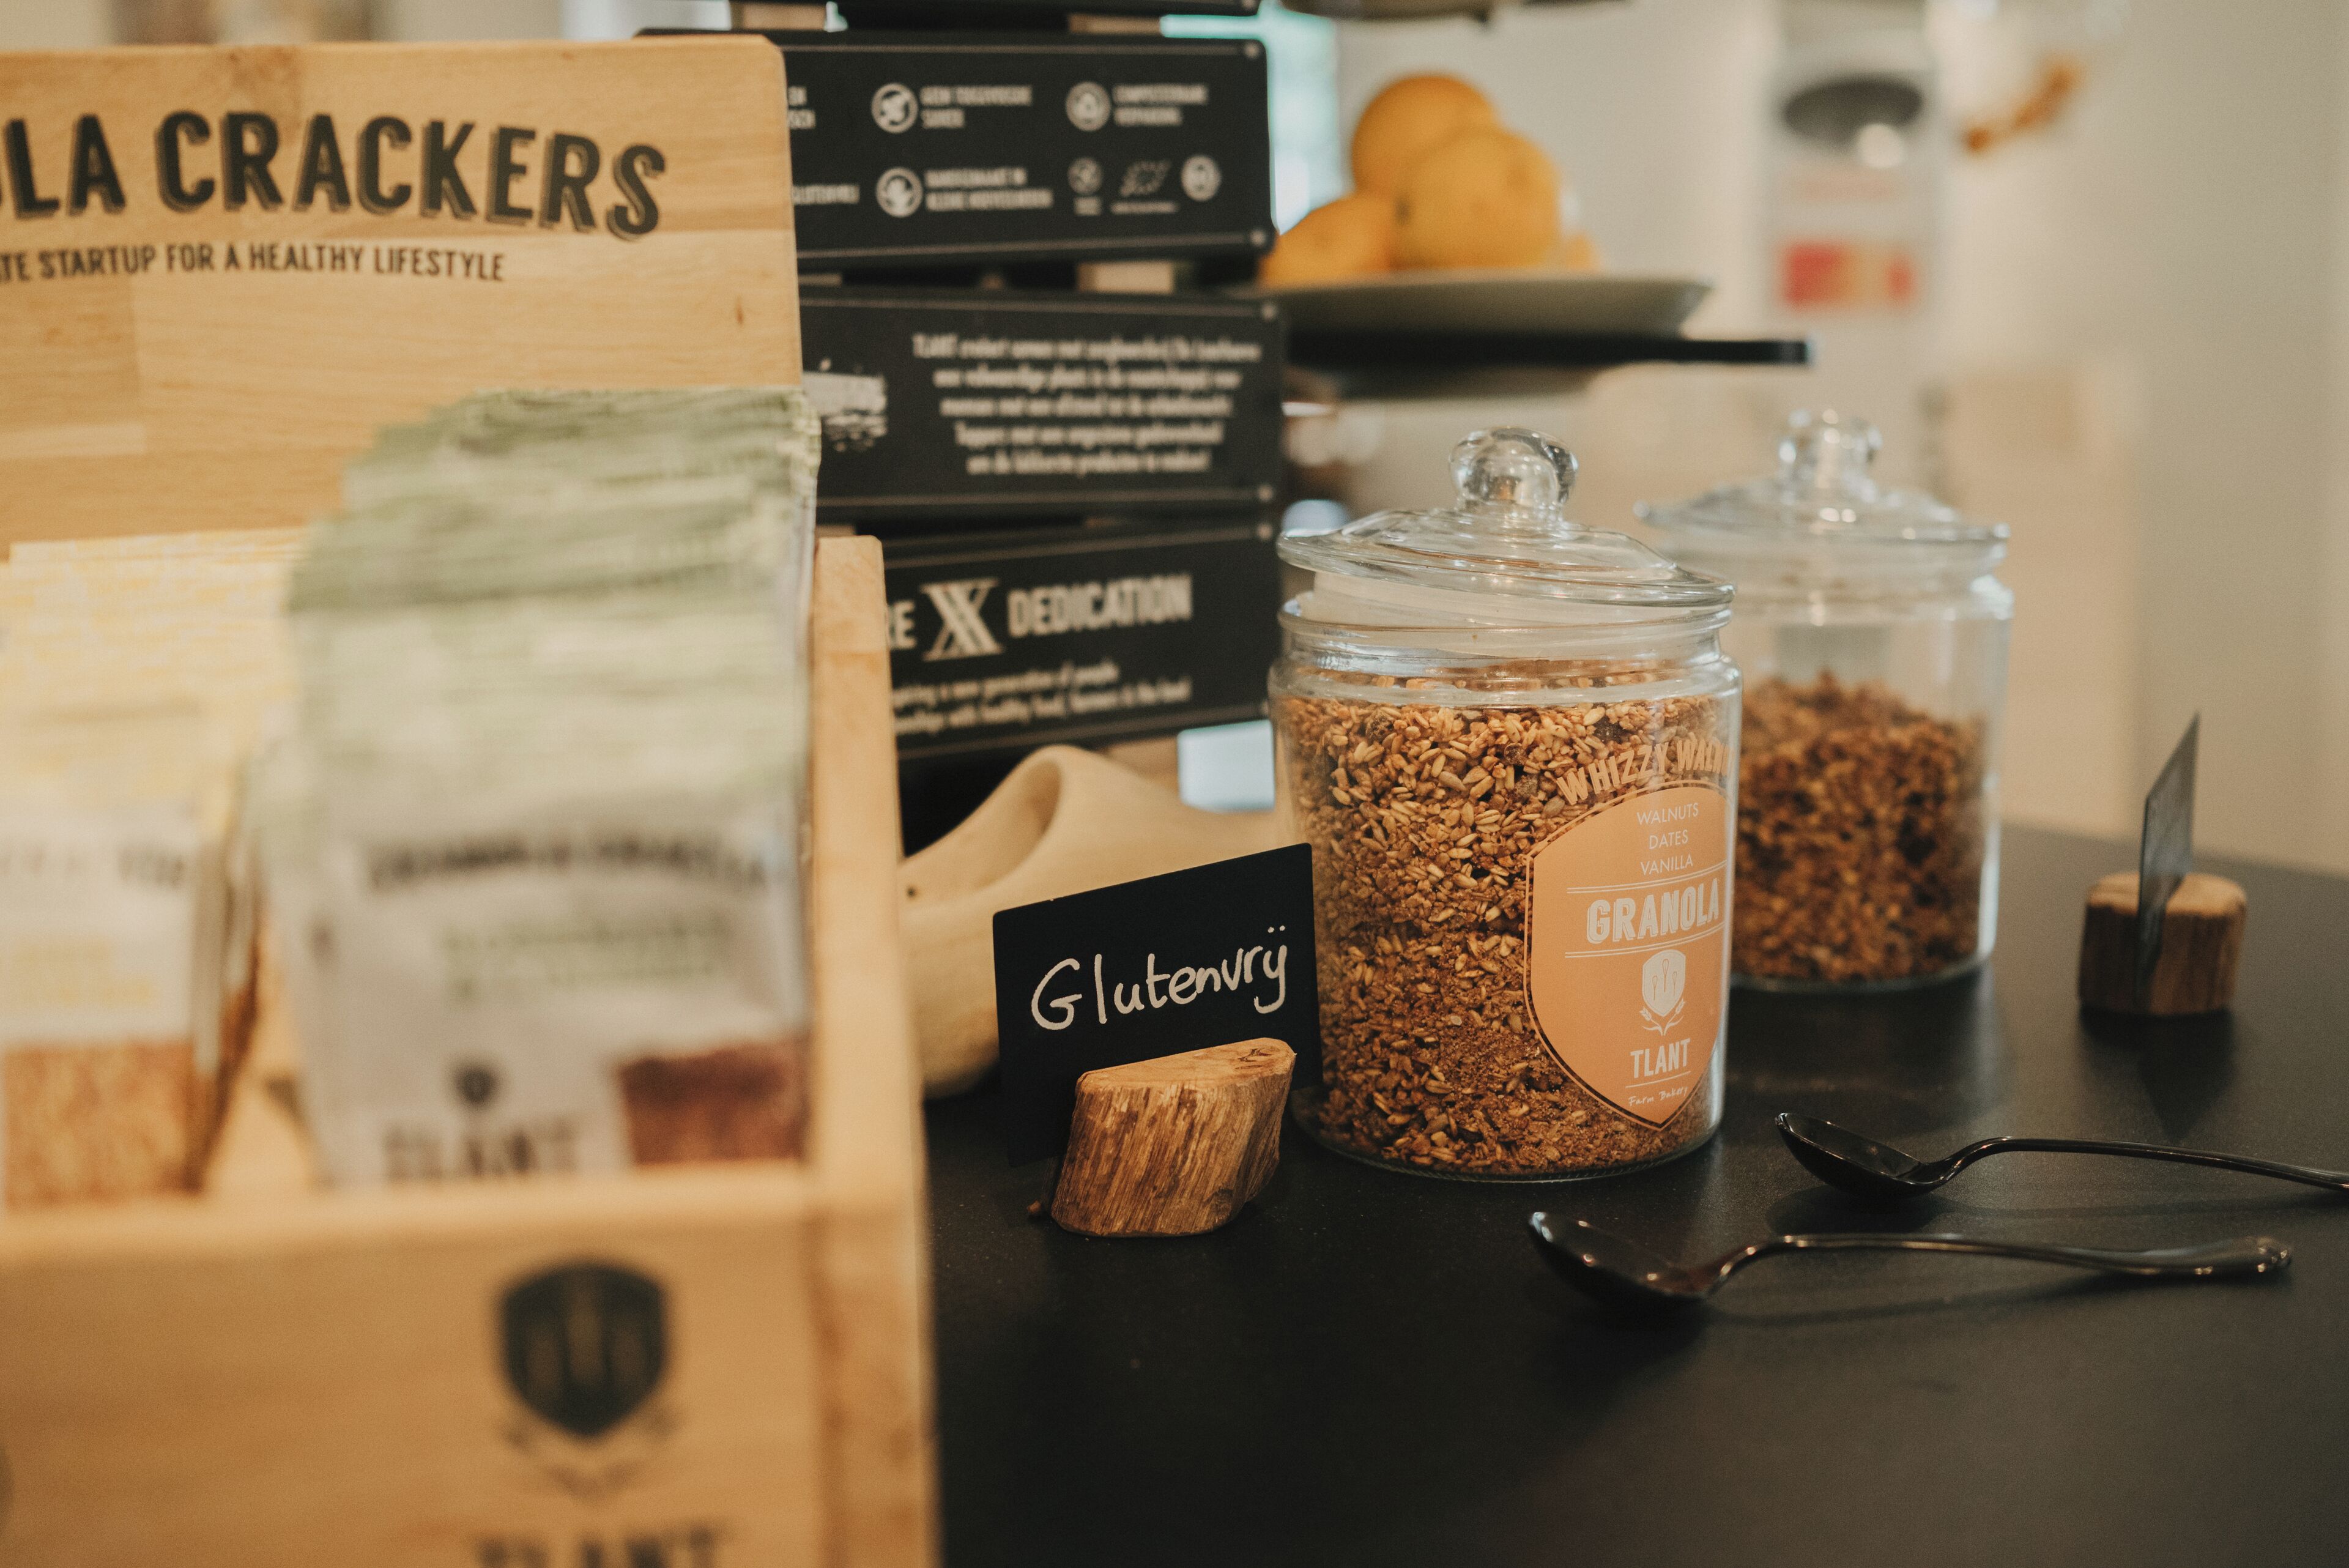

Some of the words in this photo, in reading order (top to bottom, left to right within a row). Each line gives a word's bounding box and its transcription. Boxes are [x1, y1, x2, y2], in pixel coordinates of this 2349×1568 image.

[0, 112, 126, 219] LA
[154, 110, 666, 241] CRACKERS
[0, 250, 31, 282] TE
[37, 244, 156, 280] STARTUP
[167, 243, 214, 272] FOR
[224, 243, 241, 271] A
[248, 243, 364, 272] HEALTHY
[374, 246, 505, 281] LIFESTYLE
[1006, 573, 1193, 639] DEDICATION
[1556, 741, 1669, 806] WHIZZY
[1636, 802, 1699, 825] WALNUTS
[1649, 829, 1689, 850] DATES
[1640, 853, 1694, 876] VANILLA
[1586, 877, 1720, 945] GRANOLA
[1630, 1037, 1691, 1079] TLANT
[1628, 1095, 1655, 1107] Farm
